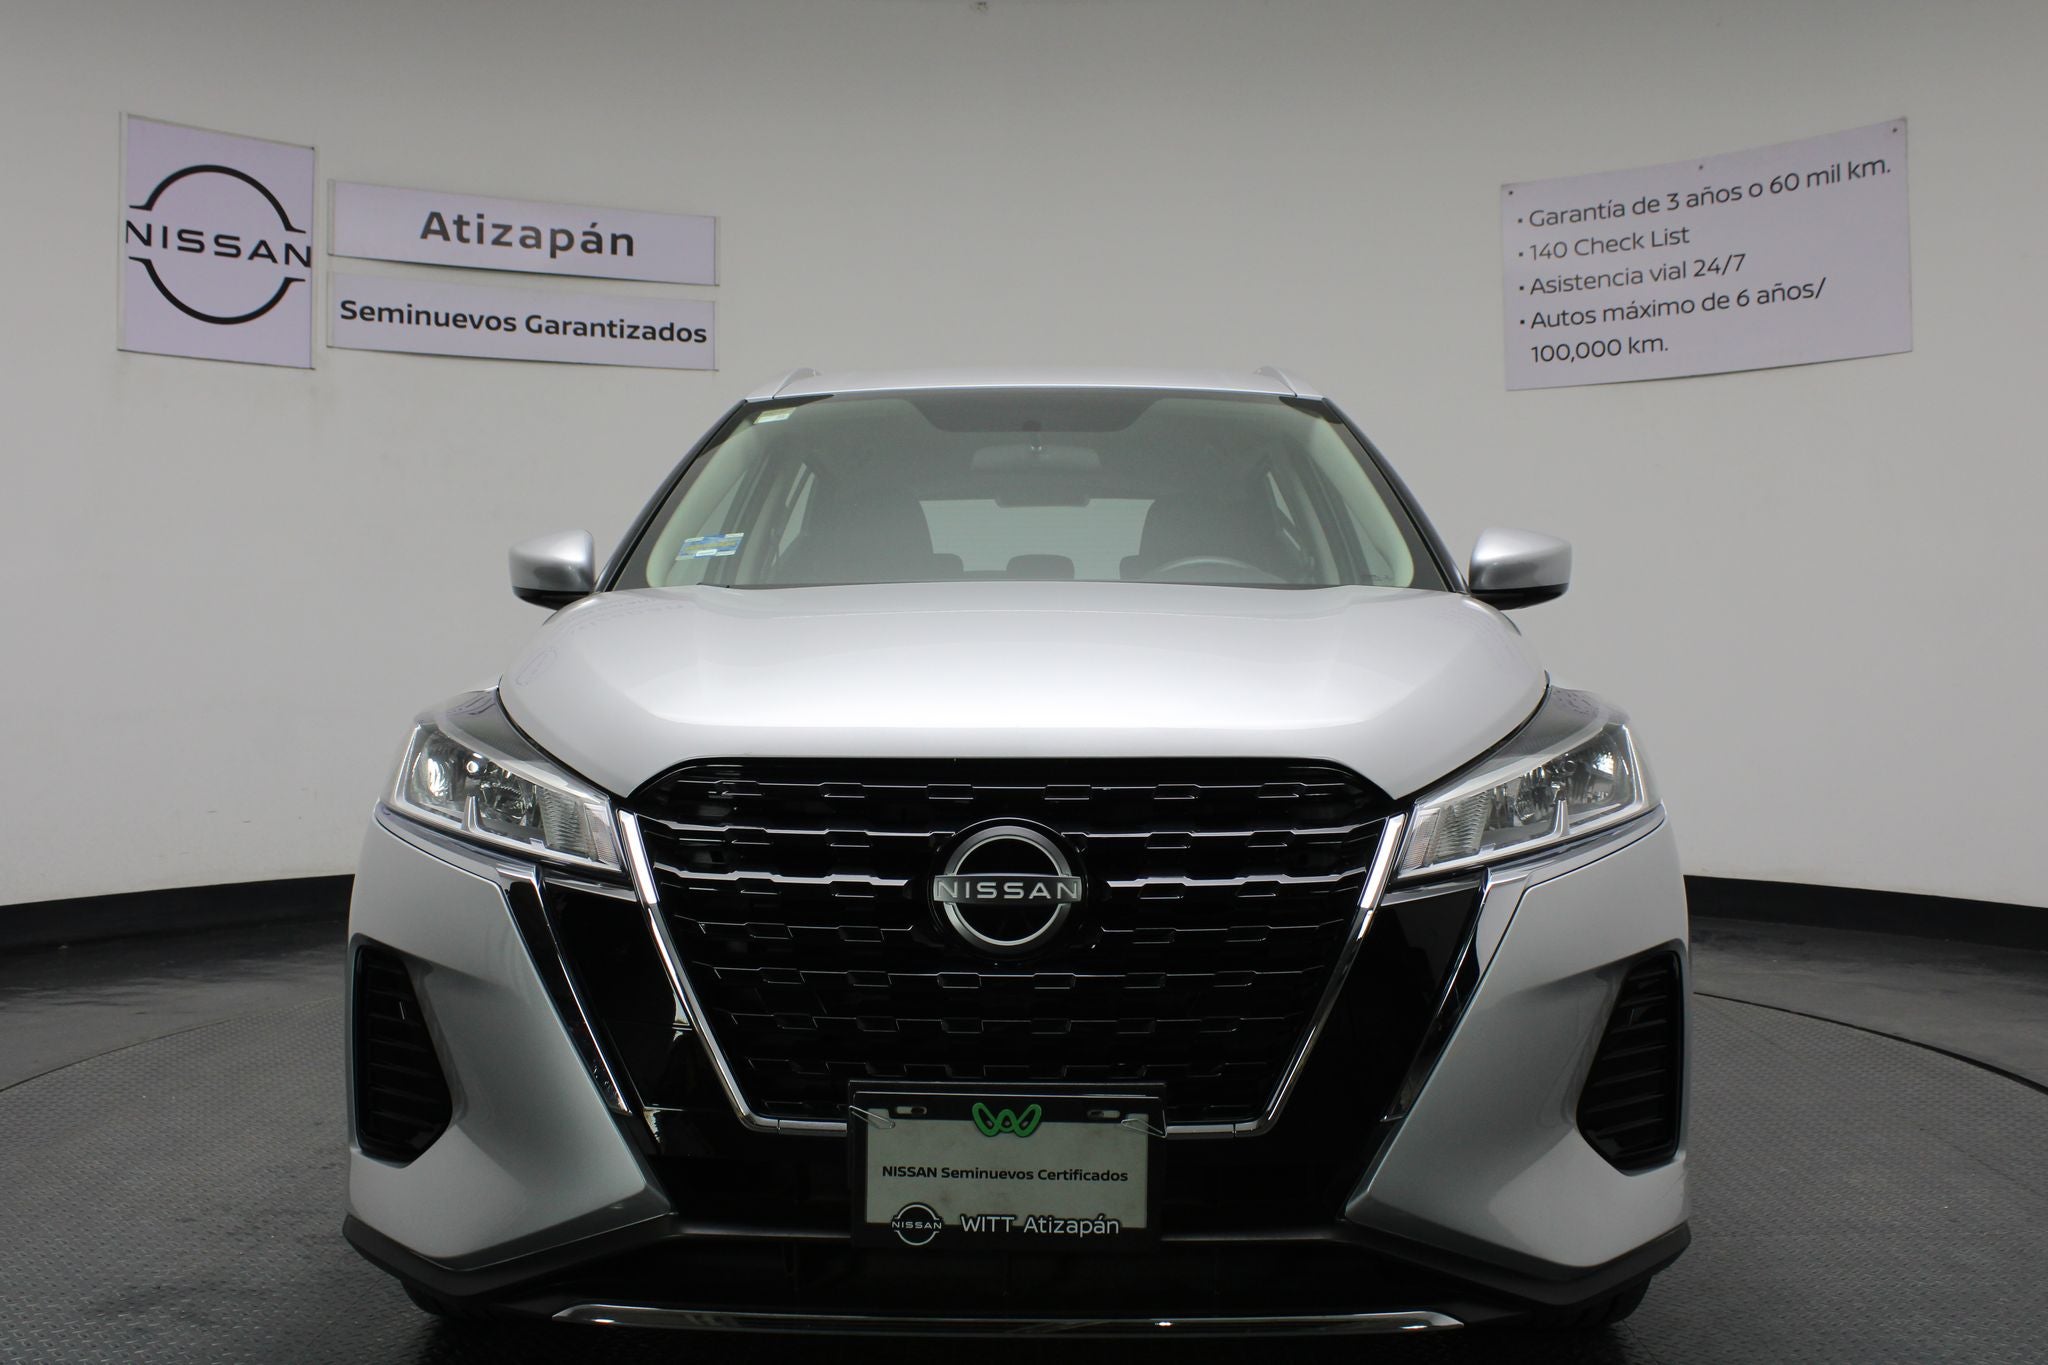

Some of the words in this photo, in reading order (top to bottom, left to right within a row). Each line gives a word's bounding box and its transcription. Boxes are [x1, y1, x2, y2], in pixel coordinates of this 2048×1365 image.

[1529, 200, 1625, 228] Garantía
[1632, 196, 1661, 215] de
[1666, 193, 1680, 211] 3
[1686, 184, 1743, 208] años
[1749, 182, 1763, 198] o
[1770, 172, 1800, 195] 60
[1807, 163, 1841, 189] mil
[1848, 155, 1892, 181] km.
[125, 219, 312, 268] NISSAN
[420, 210, 635, 259] Atizapán
[1529, 241, 1568, 261] 140
[1574, 233, 1645, 257] Check
[1651, 226, 1690, 247] List
[1530, 267, 1644, 295] Asistencia
[1649, 260, 1687, 282] vial
[1693, 253, 1746, 277] 24/7
[340, 300, 517, 333] Seminuevos
[524, 315, 708, 344] Garantizados
[1530, 308, 1597, 329] Autos
[1603, 298, 1695, 321] máximo
[1701, 293, 1731, 311] de
[1736, 290, 1750, 307] 6
[1756, 277, 1827, 305] años/
[1531, 338, 1622, 363] 100,000
[1628, 335, 1669, 355] km.
[937, 881, 1077, 899] NISSAN
[882, 1166, 938, 1179] NISSAN
[941, 1167, 1034, 1181] Seminuevos
[1037, 1168, 1129, 1182] Certificados
[891, 1221, 943, 1230] NISSAN
[960, 1215, 1016, 1234] WITT
[1023, 1214, 1120, 1238] Atizapán
